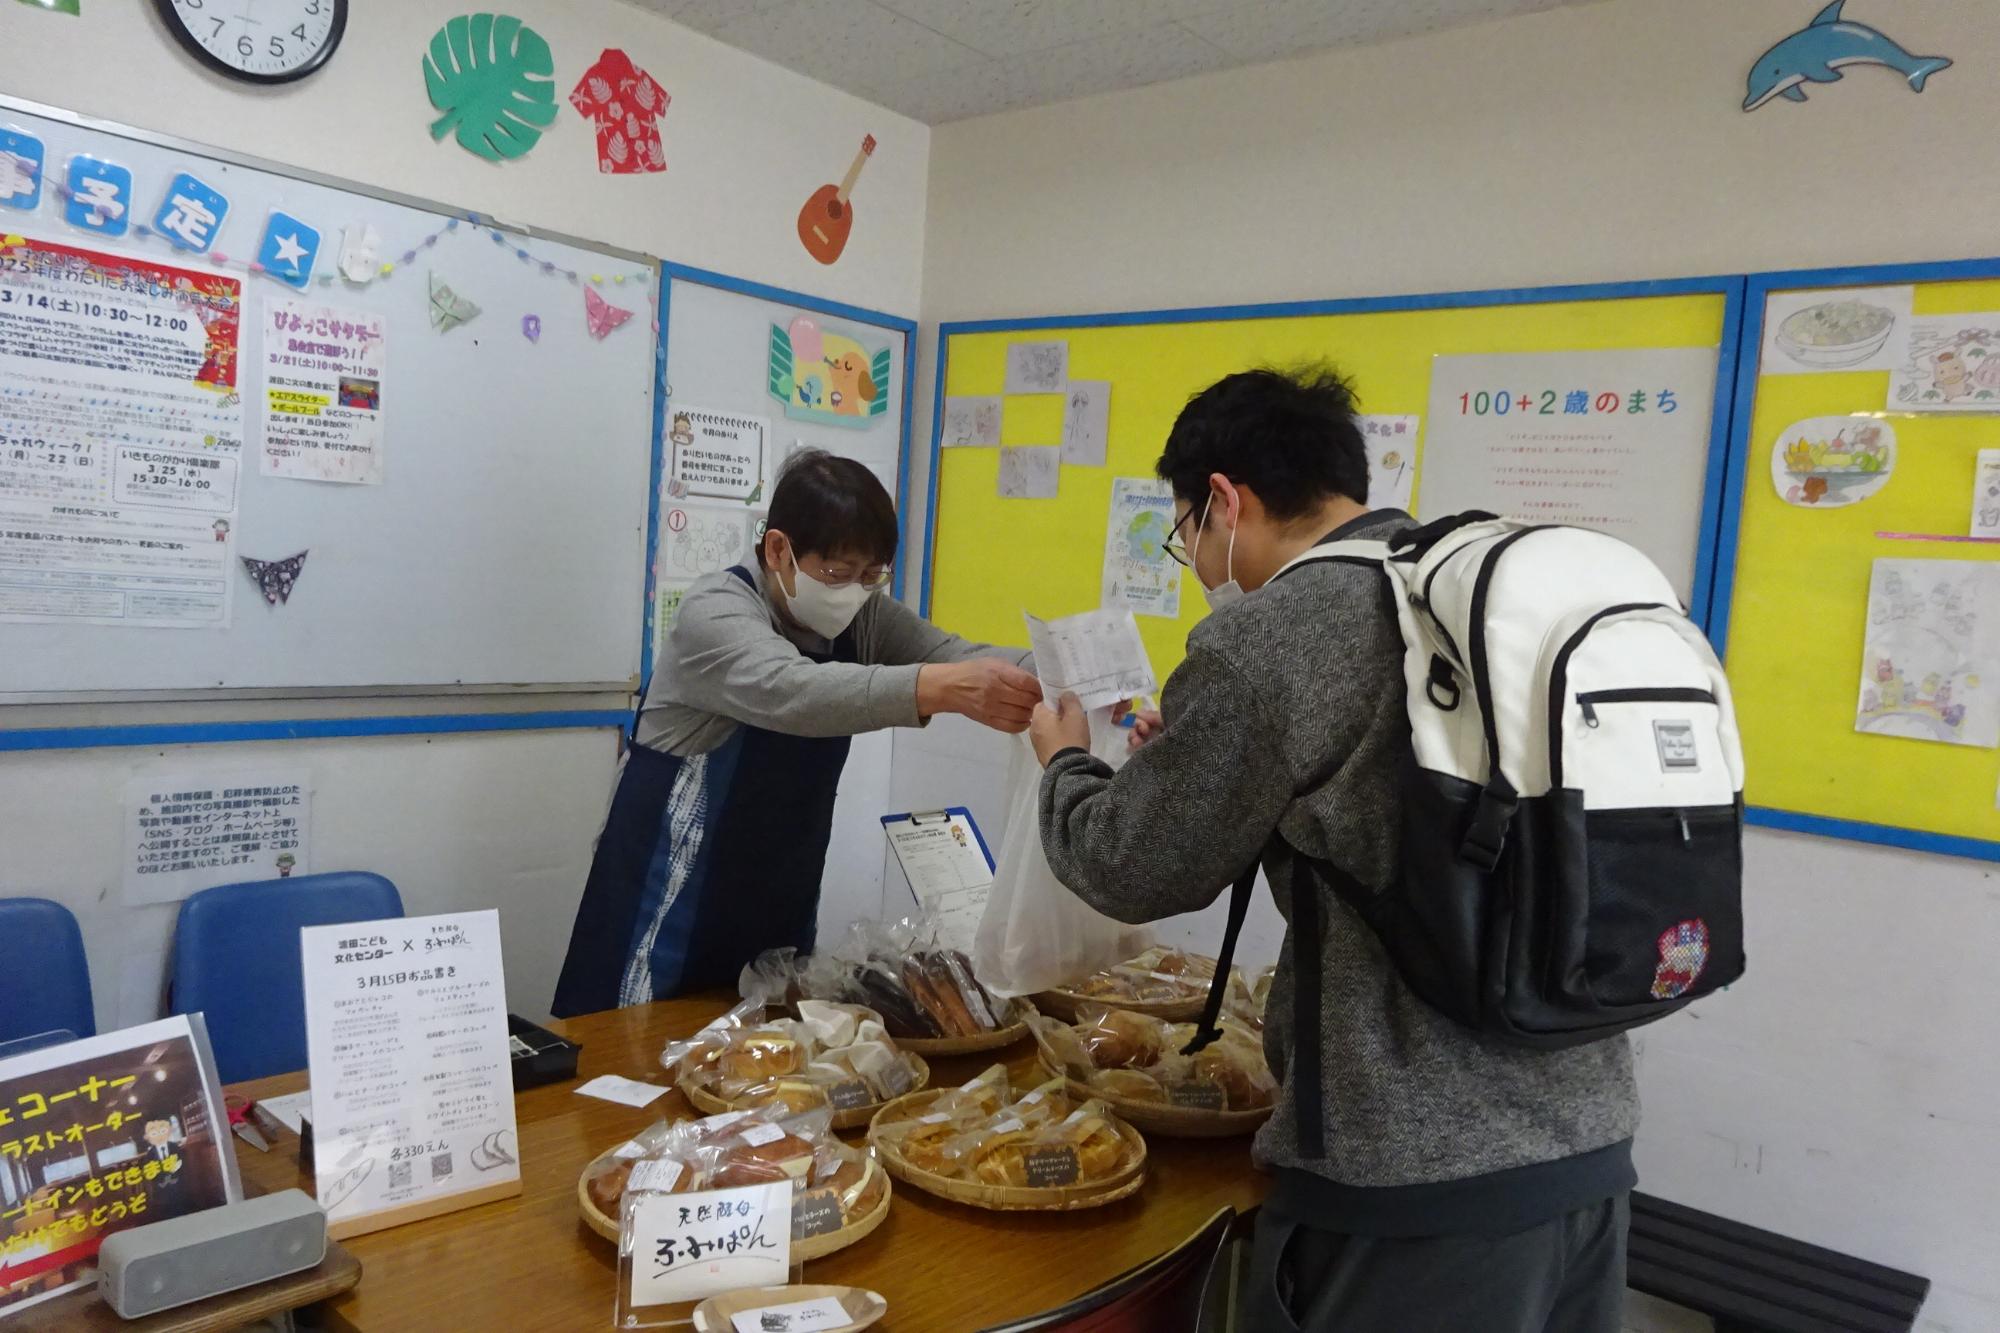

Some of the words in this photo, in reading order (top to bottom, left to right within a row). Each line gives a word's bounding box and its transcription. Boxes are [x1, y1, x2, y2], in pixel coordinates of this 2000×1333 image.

[209, 17, 225, 38] 7
[291, 24, 307, 42] 4
[237, 36, 253, 56] 6
[269, 36, 285, 57] 5
[682, 449, 751, 465] ぬりたいものがあったら
[334, 948, 393, 964] 文化センター
[356, 965, 457, 989] 3月15日お品書き
[2, 1111, 142, 1159] ラストオーダー
